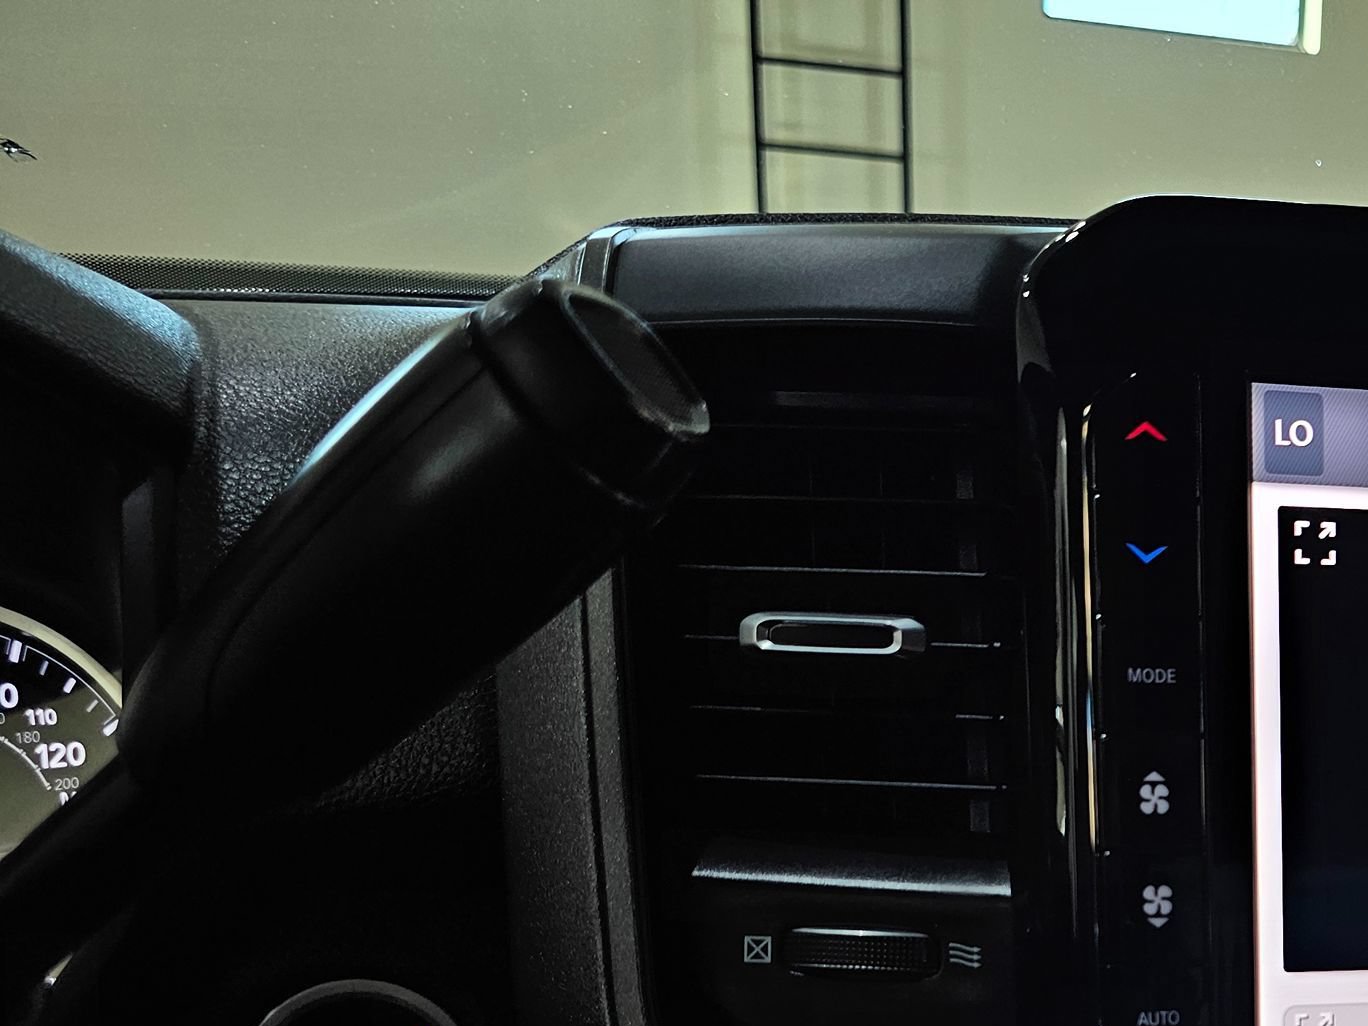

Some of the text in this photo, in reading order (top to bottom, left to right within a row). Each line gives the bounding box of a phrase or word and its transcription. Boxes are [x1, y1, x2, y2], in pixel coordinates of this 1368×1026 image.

[1274, 418, 1314, 448] LO
[1127, 667, 1177, 684] MODE
[24, 708, 58, 726] 110
[15, 731, 41, 744] 180
[34, 741, 87, 770] 120
[55, 777, 80, 790] 200
[1136, 1009, 1181, 1026] AUTO
